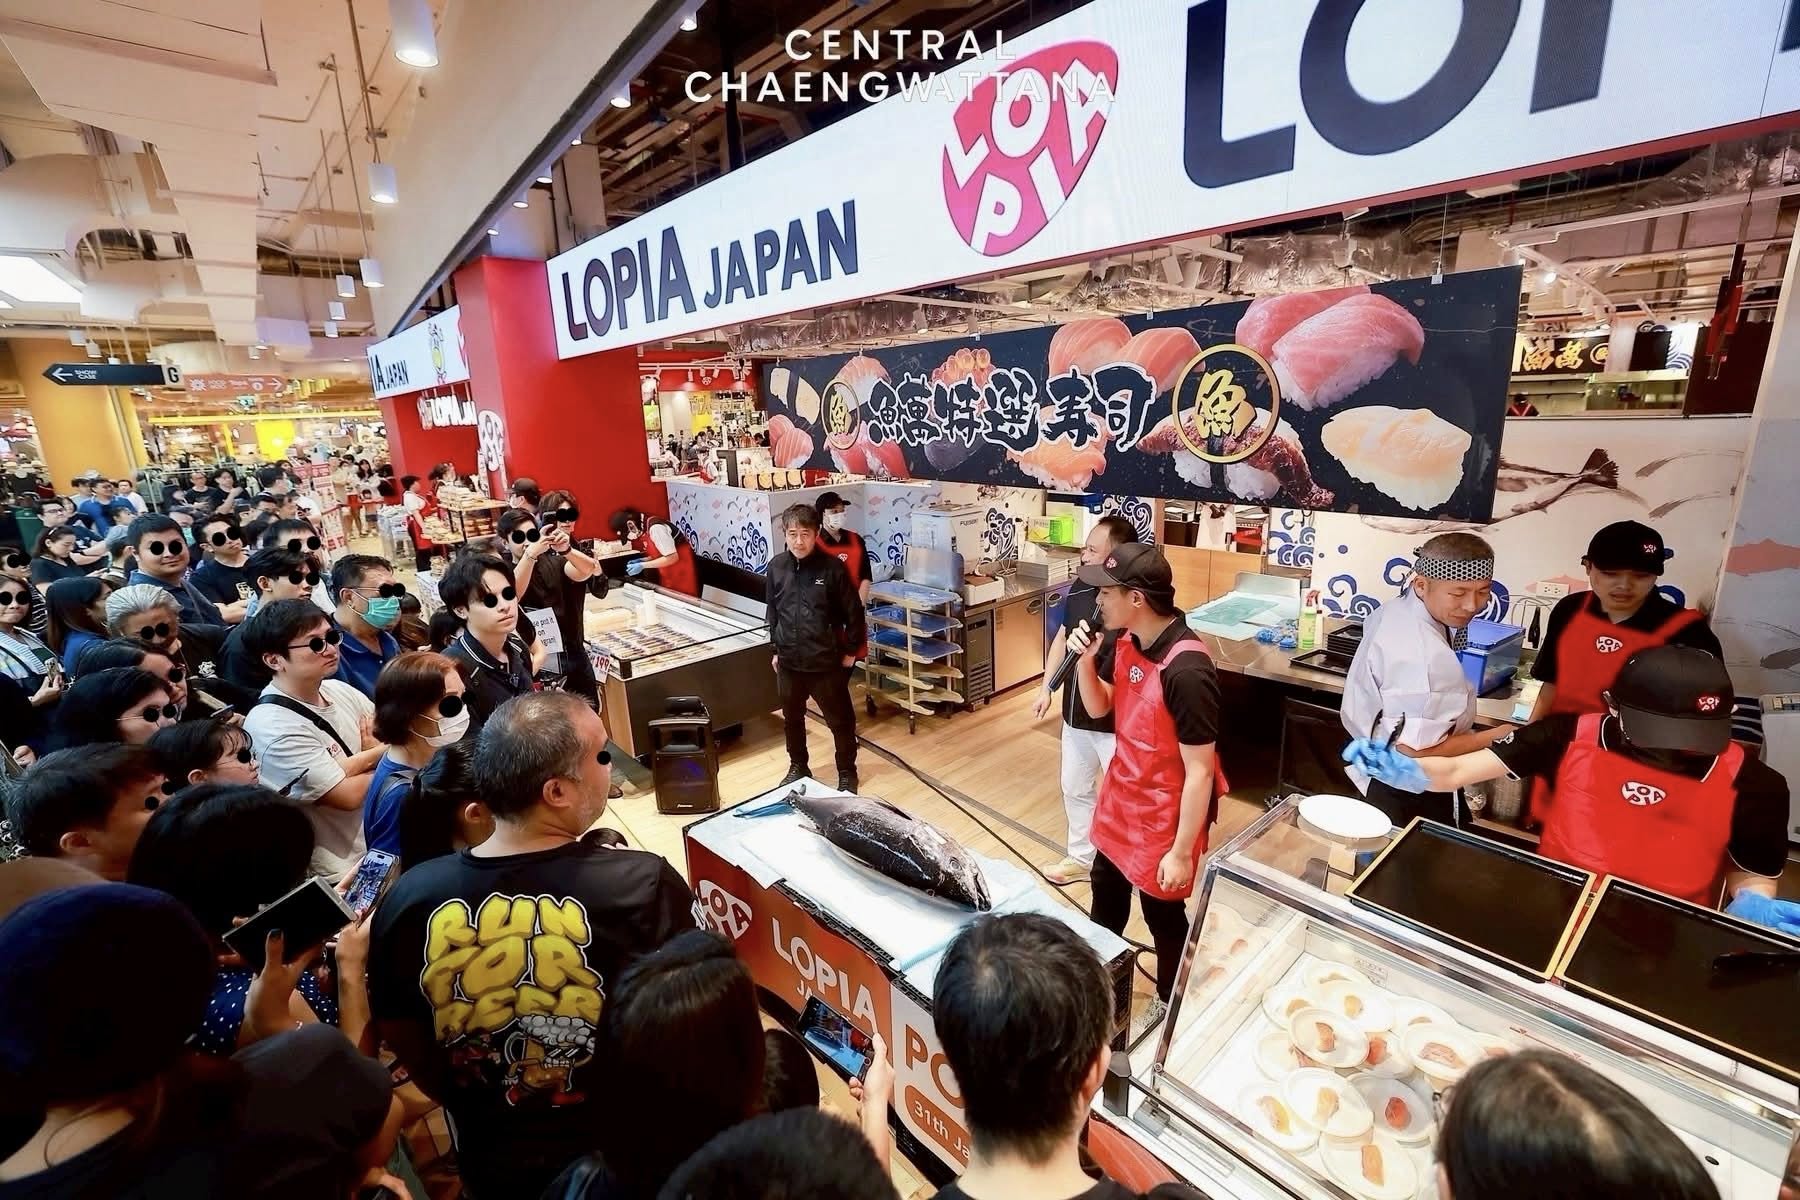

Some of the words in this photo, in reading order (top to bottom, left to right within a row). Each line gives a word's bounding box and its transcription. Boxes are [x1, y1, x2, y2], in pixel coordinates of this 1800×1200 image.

[562, 225, 697, 341] LOPIA
[703, 199, 859, 309] JAPAN
[167, 367, 180, 383] G
[385, 359, 410, 387] JAPAN
[426, 893, 591, 962] RUN
[420, 933, 602, 1010] FOR
[772, 916, 880, 1035] LOPIA
[914, 1100, 950, 1141] 31th
